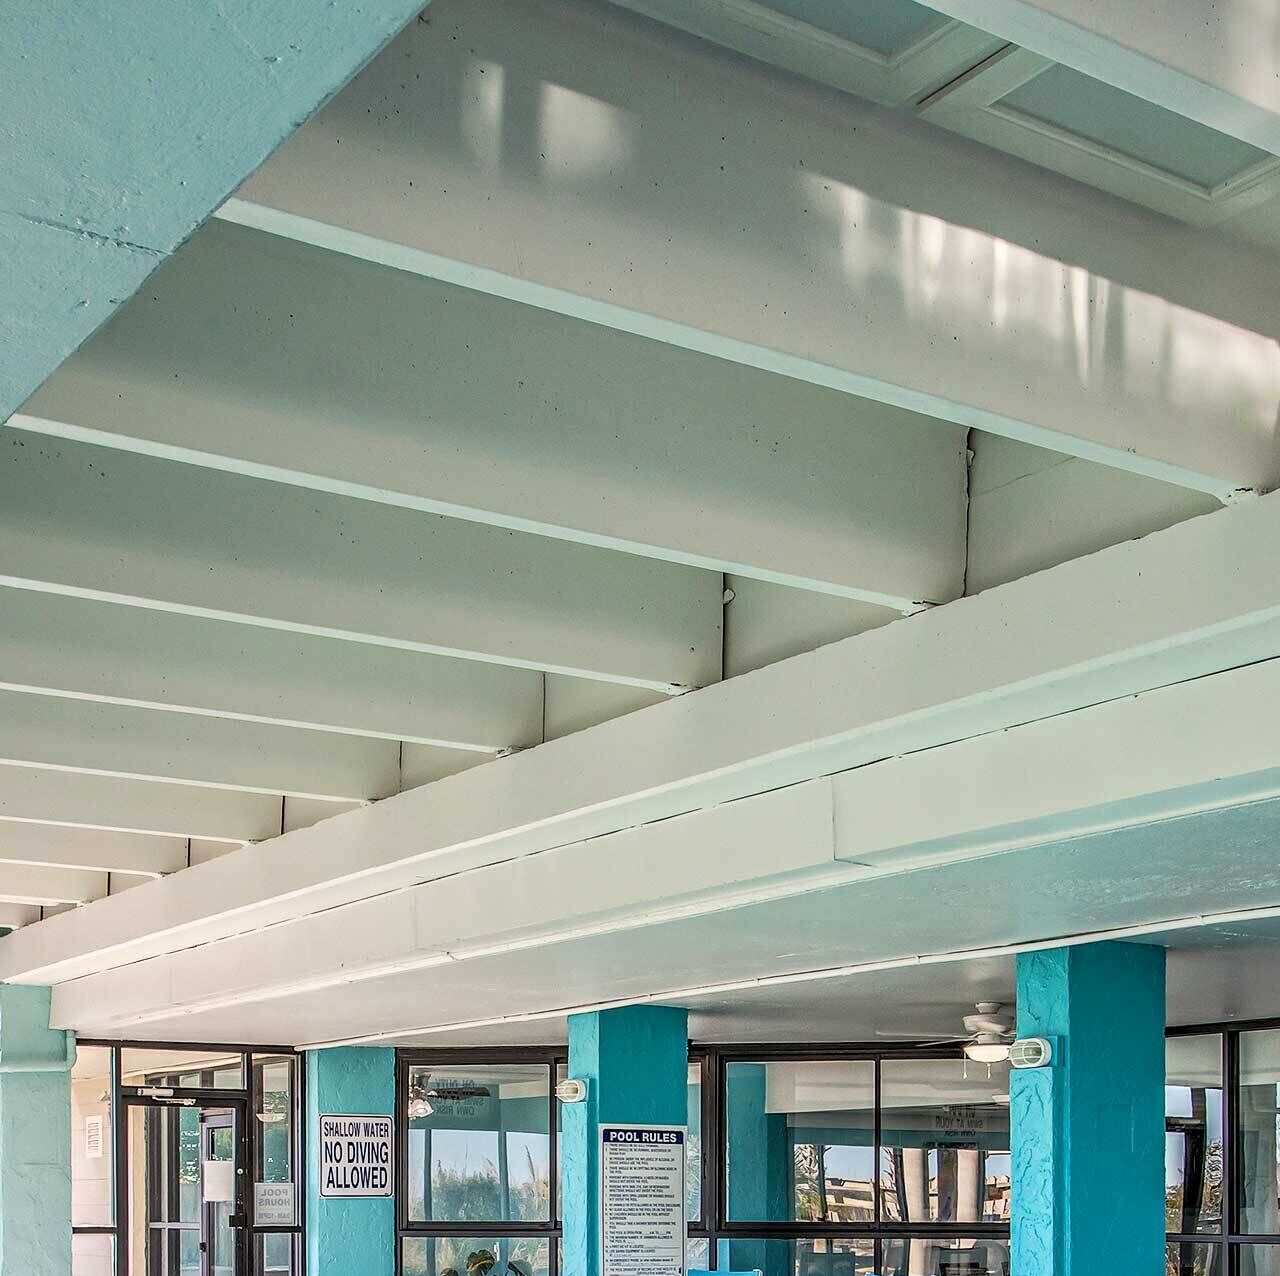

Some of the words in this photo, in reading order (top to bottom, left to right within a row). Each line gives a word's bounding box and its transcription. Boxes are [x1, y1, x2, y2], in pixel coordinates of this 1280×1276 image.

[324, 1121, 360, 1137] SHALLOW
[363, 1122, 389, 1138] WATER
[609, 1131, 640, 1142] POOL
[642, 1132, 677, 1143] RULES
[324, 1141, 343, 1163] NO
[347, 1141, 389, 1164] DIVING
[326, 1166, 388, 1189] ALLOWED
